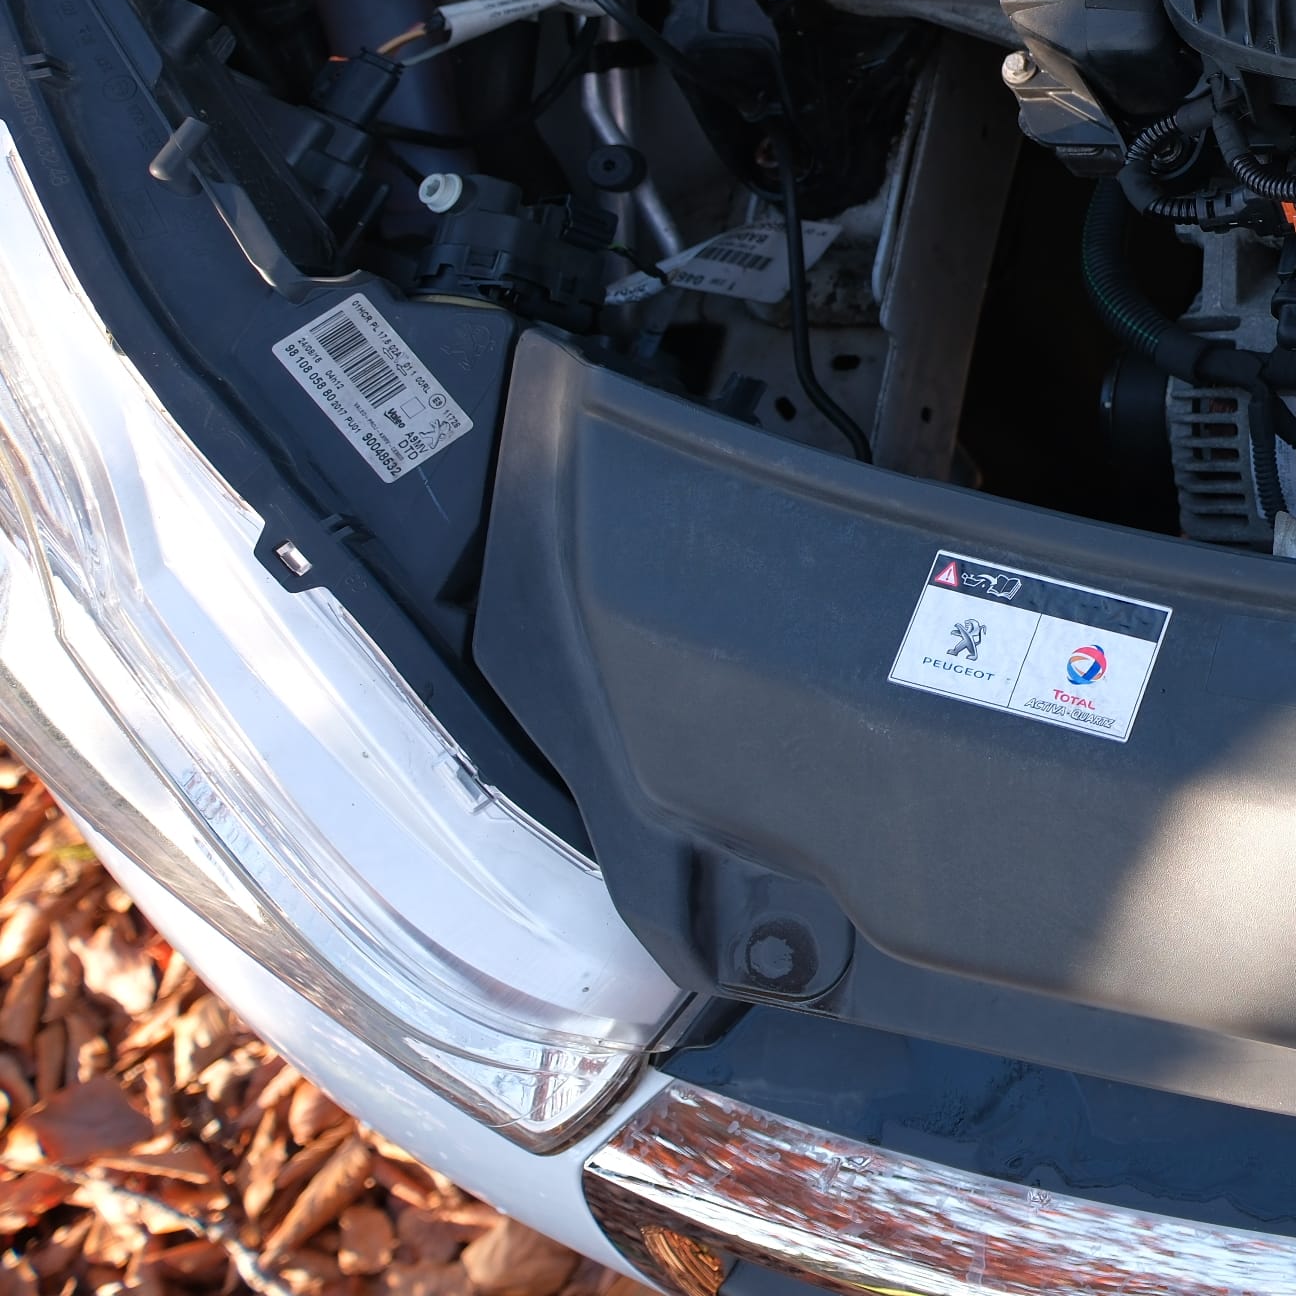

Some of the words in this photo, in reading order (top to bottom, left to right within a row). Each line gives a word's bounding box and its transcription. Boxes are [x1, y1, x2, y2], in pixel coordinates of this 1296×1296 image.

[369, 321, 381, 332] PL
[284, 344, 299, 357] 98
[295, 356, 314, 374] 108
[308, 372, 327, 390] 058
[322, 388, 337, 402] 80
[324, 370, 344, 390] 04h12
[386, 408, 408, 429] Valeo
[397, 439, 420, 461] DTD
[404, 430, 429, 455] A9MV
[922, 656, 995, 681] PEUGEOT
[1053, 689, 1096, 710] TOTAL
[1024, 697, 1067, 717] ACTIVA
[1070, 708, 1116, 729] QUARTZ
